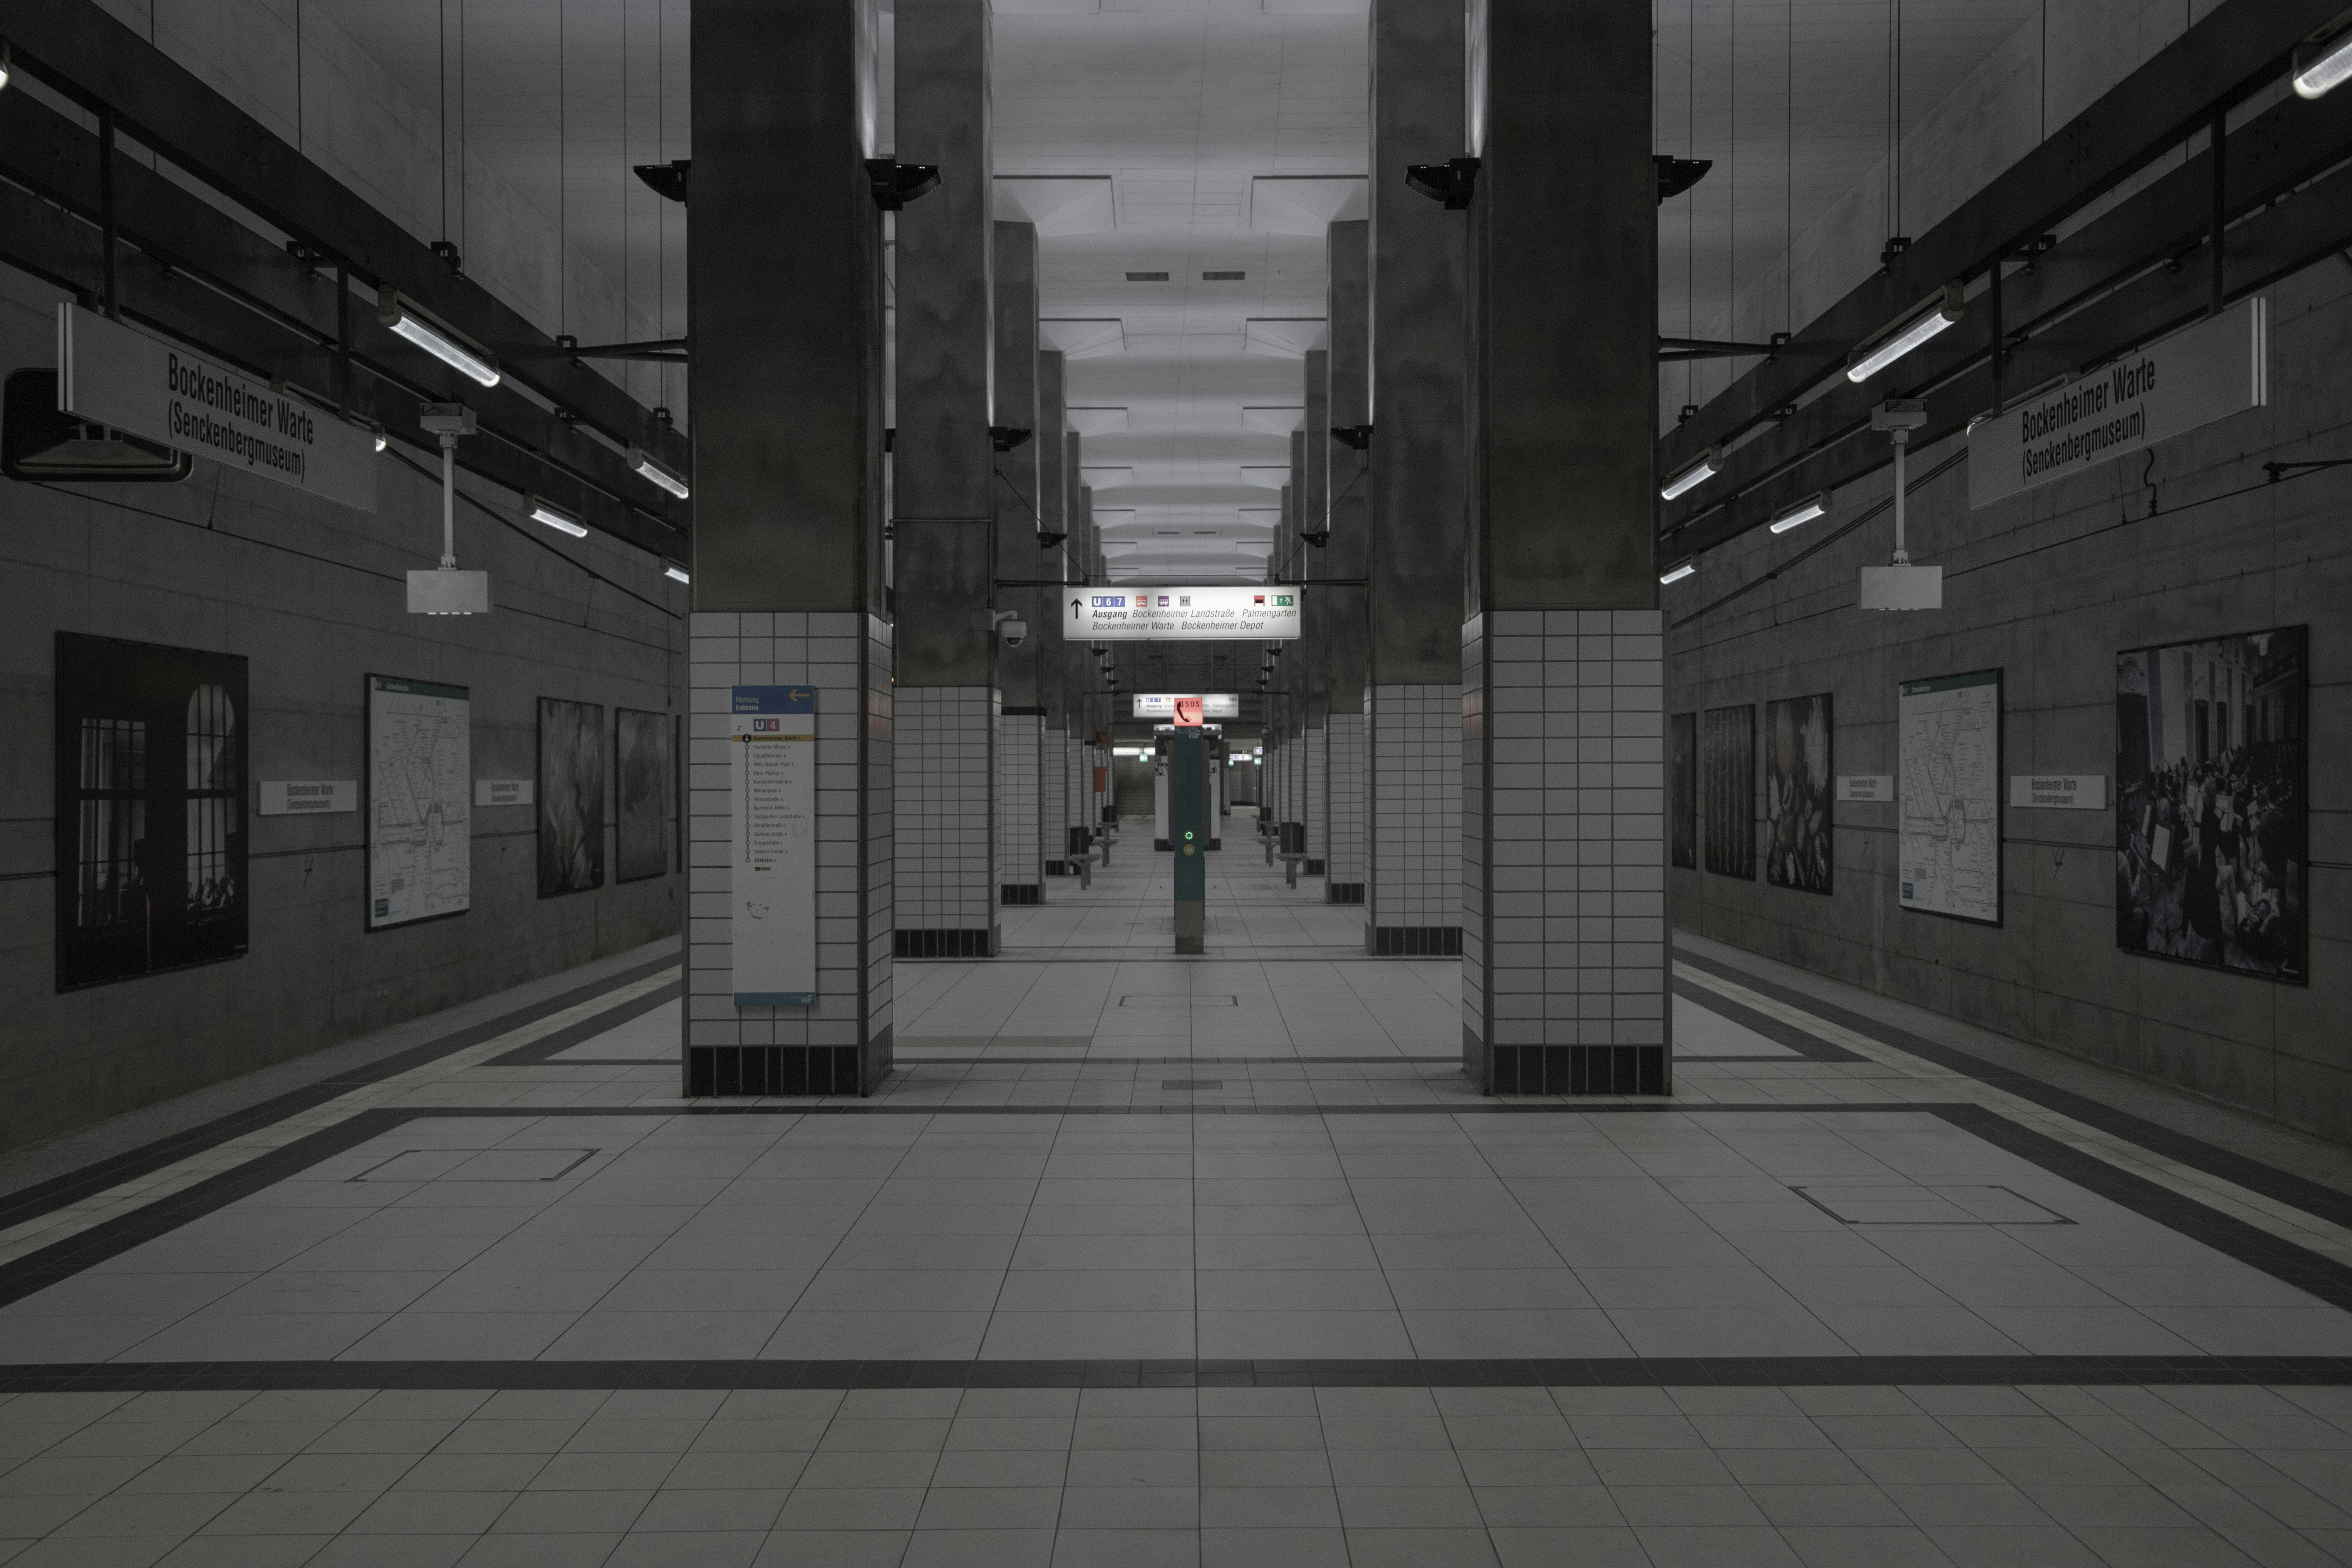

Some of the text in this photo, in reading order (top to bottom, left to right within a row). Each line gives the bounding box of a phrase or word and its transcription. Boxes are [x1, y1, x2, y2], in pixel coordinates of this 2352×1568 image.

[168, 352, 313, 444] Bockenheimer Warte
[2023, 357, 2154, 444] Bockenheimer Warte
[168, 399, 305, 484] (Senckenbergmuseum)
[2023, 402, 2145, 485] (Senckenbergmuseum)
[1092, 609, 1296, 619] Ausgang Bockenheimer Landstraße Palmengarten
[1093, 621, 1264, 631] Bockenheimer Warte Bockenheimer Depot
